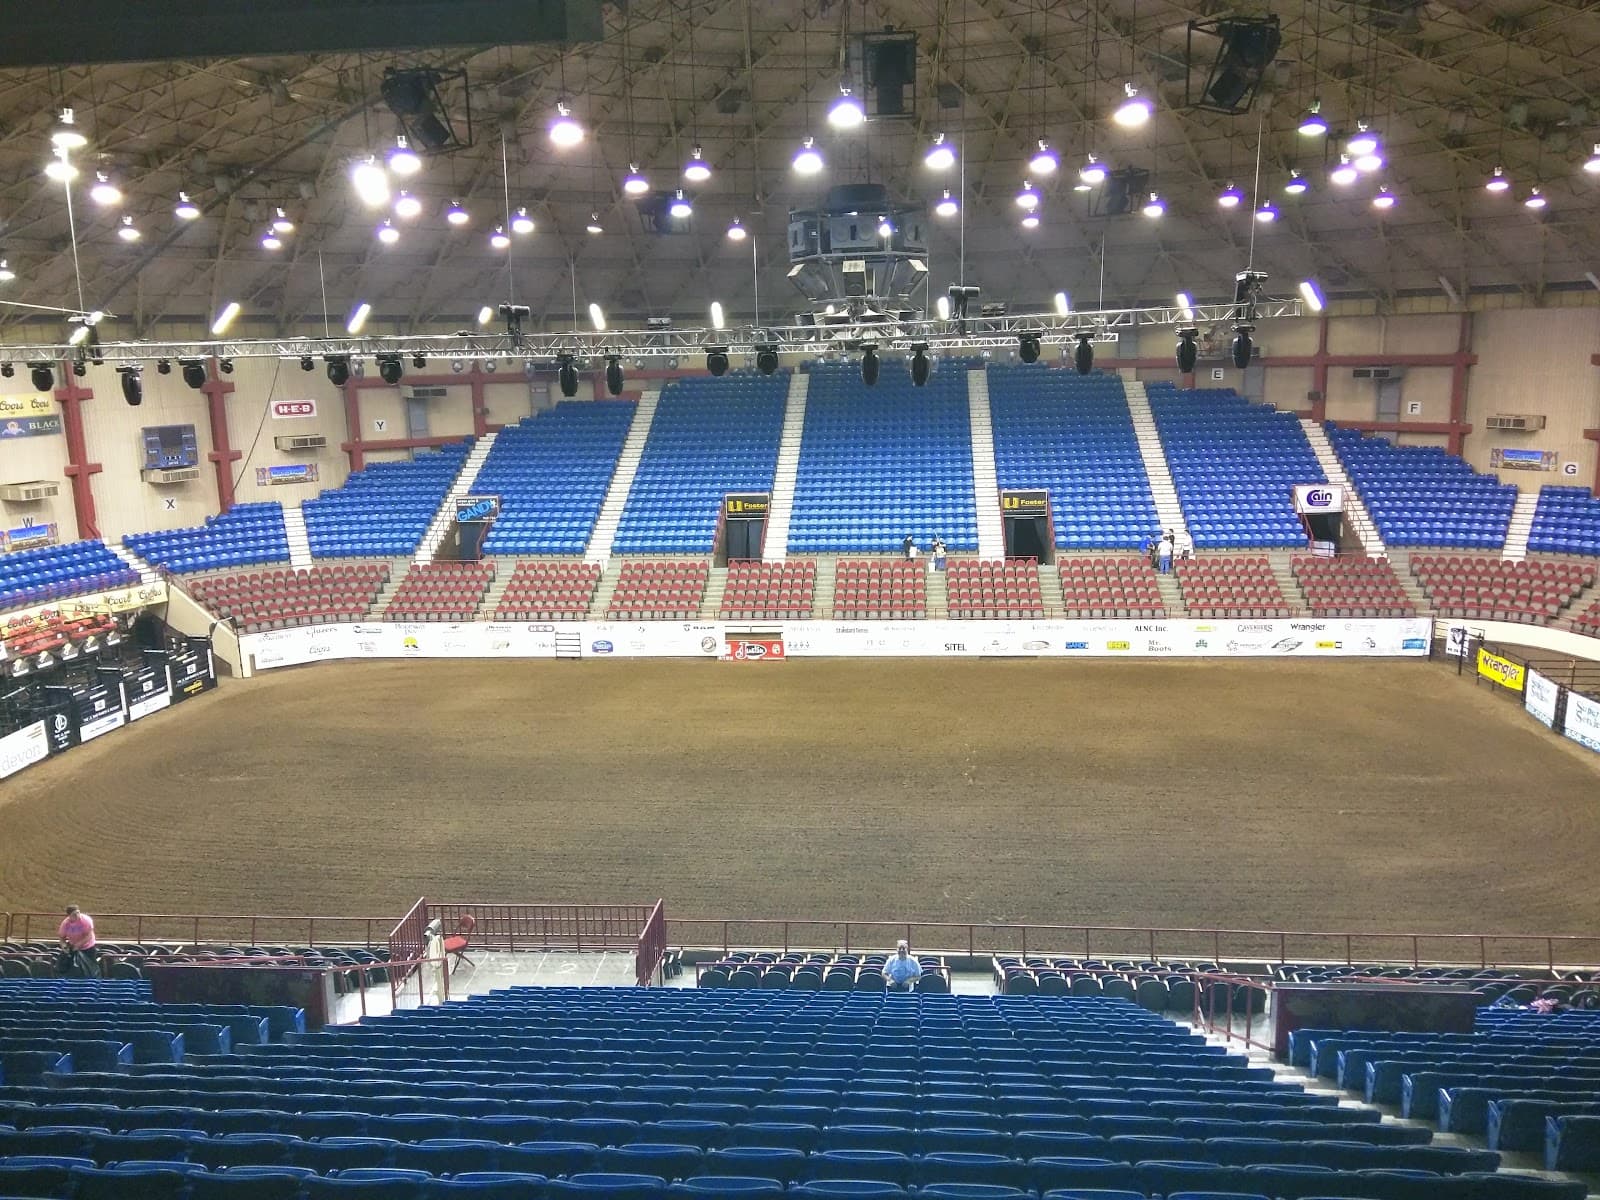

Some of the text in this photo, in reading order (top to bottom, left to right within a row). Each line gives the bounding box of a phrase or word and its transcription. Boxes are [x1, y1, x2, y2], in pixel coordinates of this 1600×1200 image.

[1214, 370, 1221, 378] E
[1411, 403, 1419, 412] F
[376, 421, 384, 430] Y
[1565, 464, 1577, 474] G
[1306, 489, 1333, 507] Cain
[166, 499, 175, 509] X
[22, 517, 33, 528] W
[1290, 623, 1326, 632] Wrangler
[944, 642, 967, 652] SITEL
[1483, 655, 1520, 681] Wrangler
[1, 743, 42, 772] devon
[495, 962, 519, 976] 3
[555, 962, 578, 975] 2
